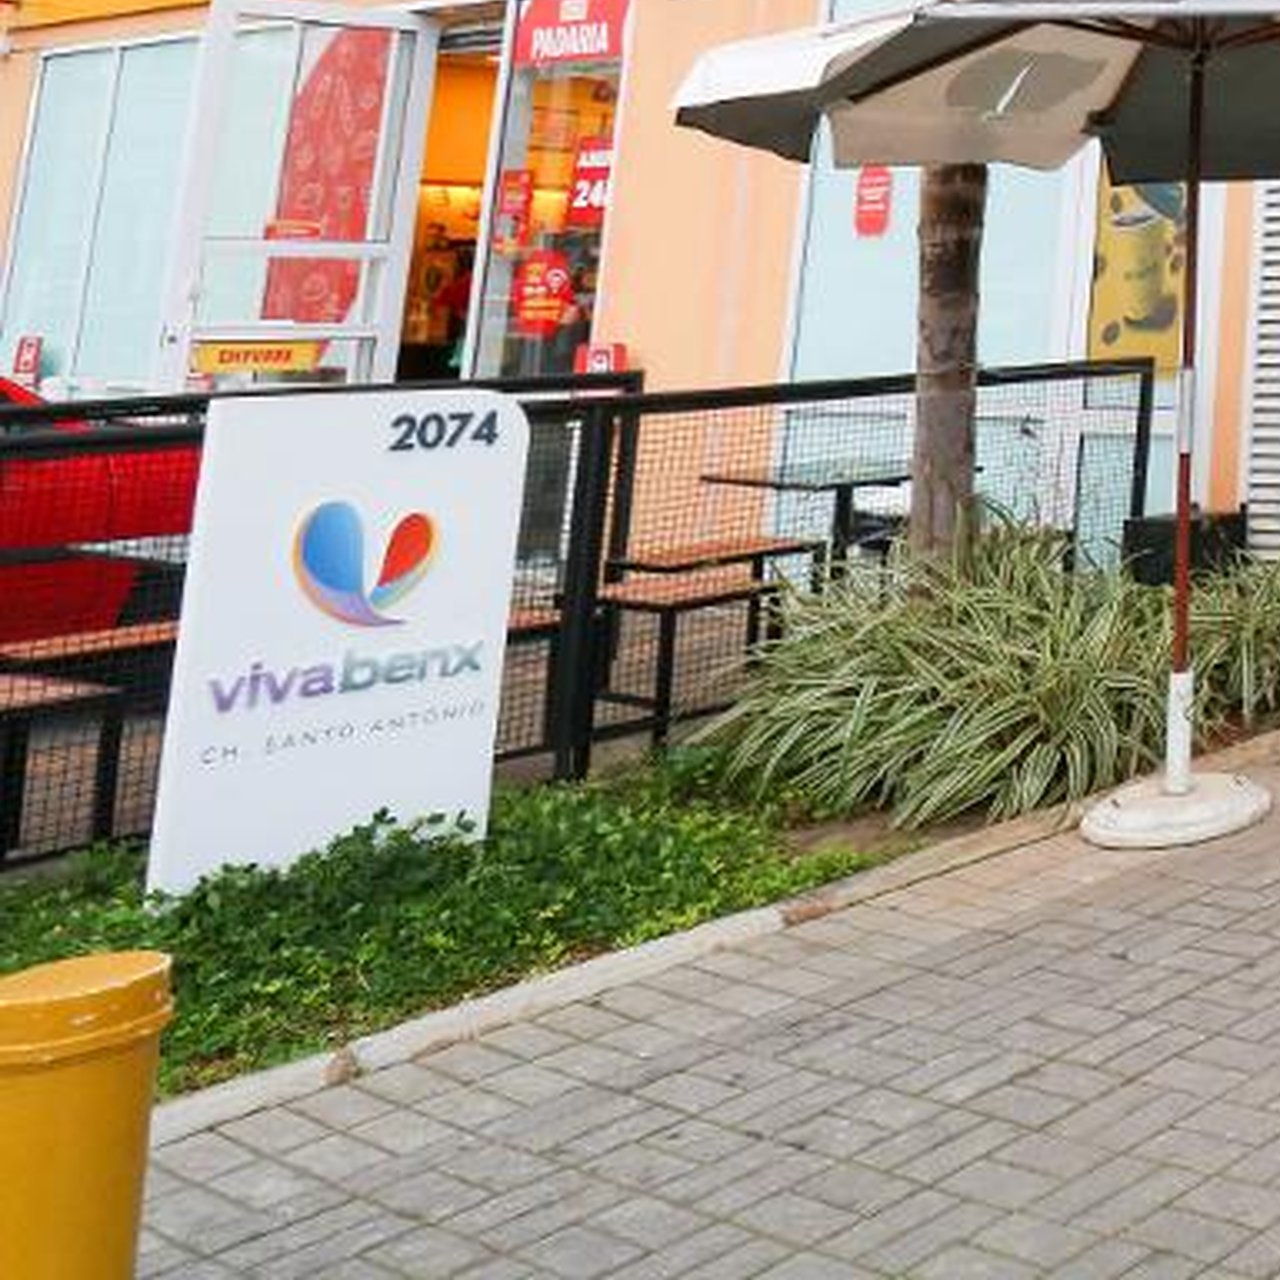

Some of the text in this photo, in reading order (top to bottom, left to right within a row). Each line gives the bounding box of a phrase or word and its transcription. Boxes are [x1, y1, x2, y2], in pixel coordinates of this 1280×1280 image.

[531, 20, 609, 61] PADARIA
[387, 409, 500, 452] 2074
[208, 639, 485, 714] vivabenx
[264, 723, 356, 756] SANTO
